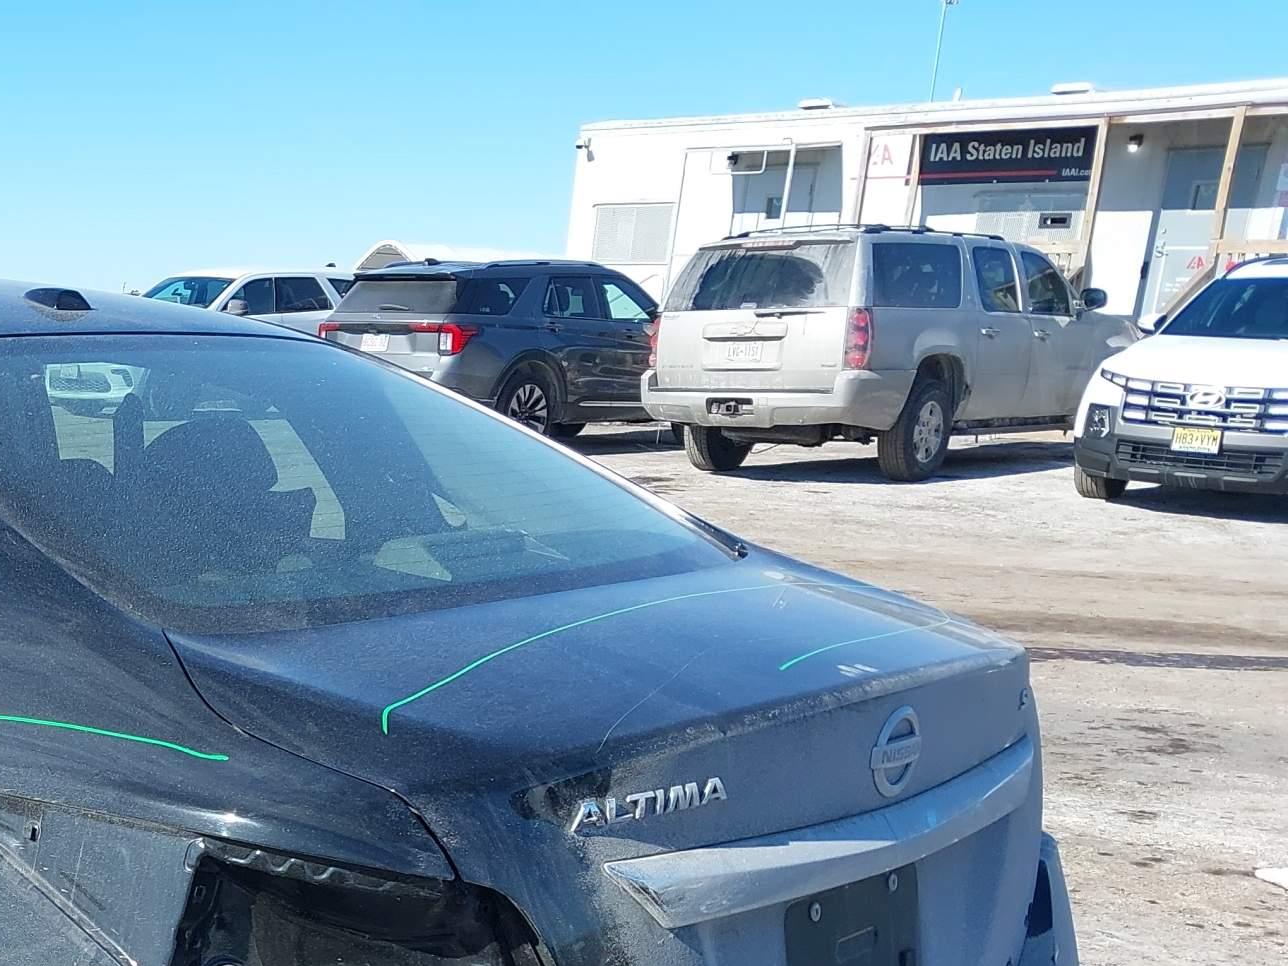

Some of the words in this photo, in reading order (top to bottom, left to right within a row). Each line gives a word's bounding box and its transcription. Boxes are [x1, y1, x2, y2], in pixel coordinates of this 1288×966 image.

[930, 142, 962, 162] IAA
[966, 139, 1024, 161] Staten
[1027, 137, 1085, 158] Island
[569, 775, 728, 833] ALTIMA
